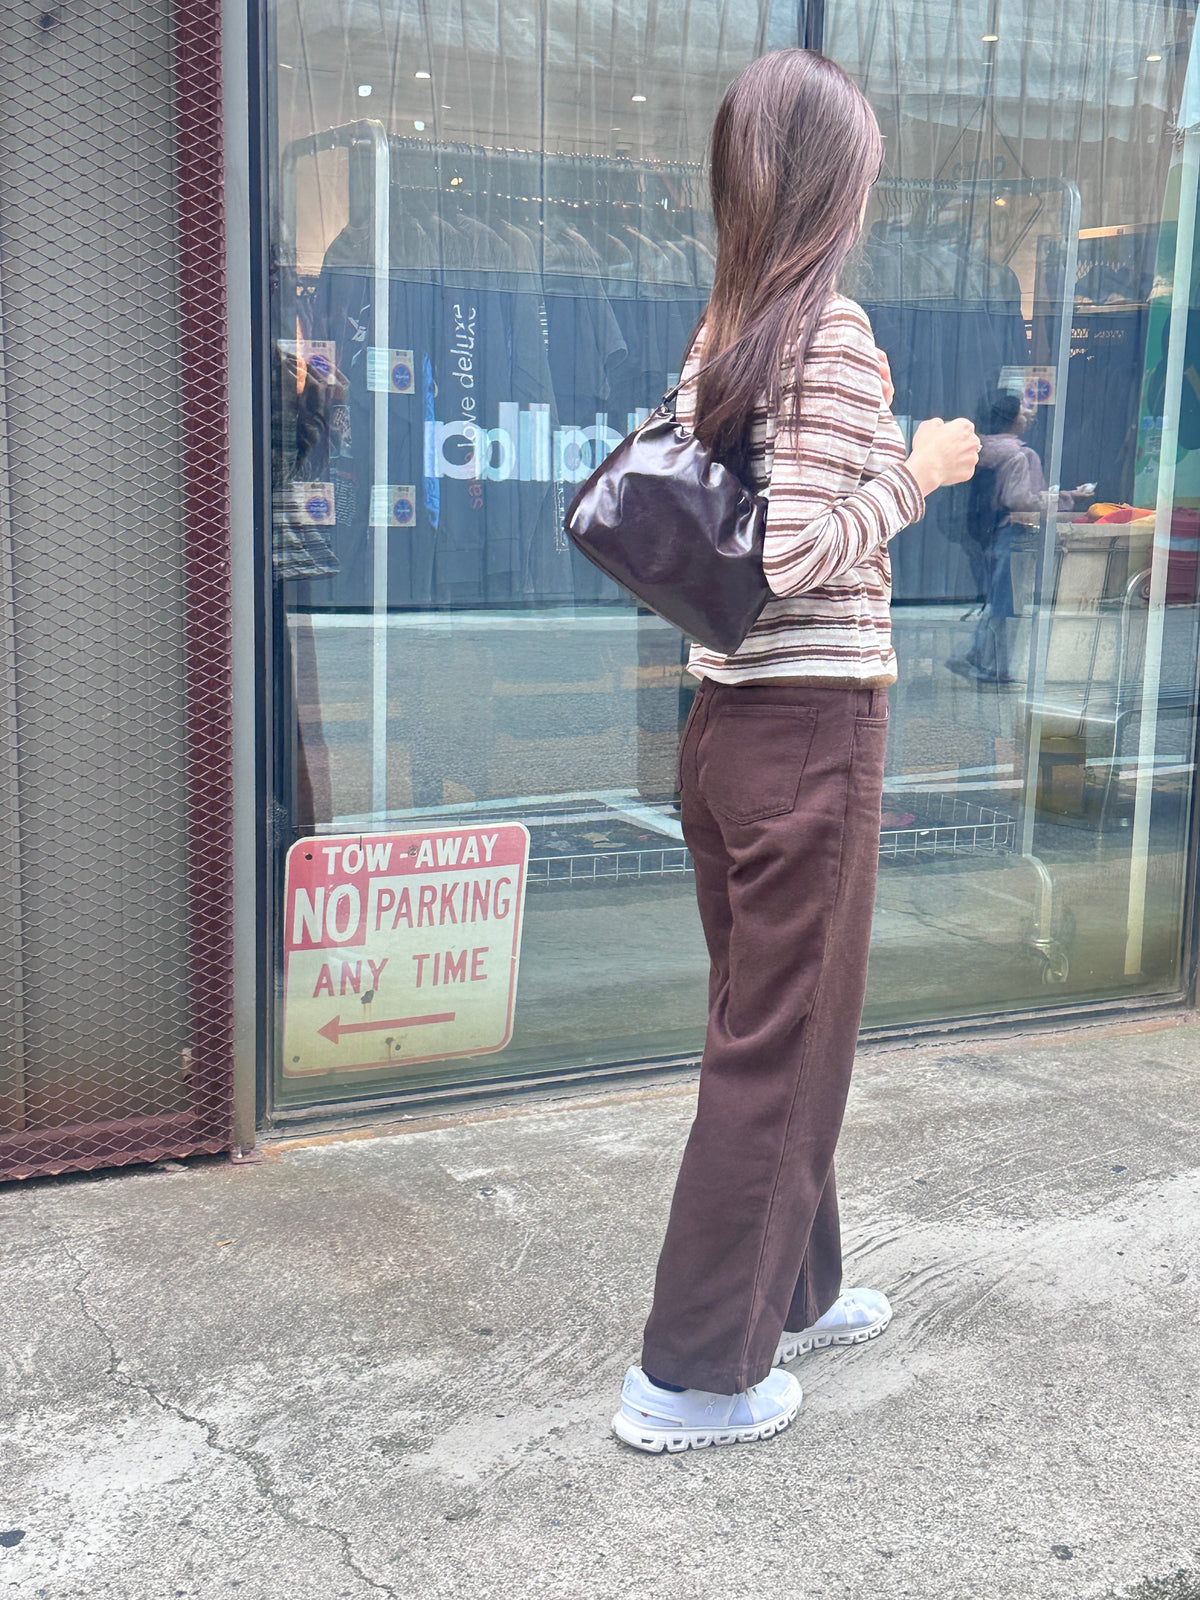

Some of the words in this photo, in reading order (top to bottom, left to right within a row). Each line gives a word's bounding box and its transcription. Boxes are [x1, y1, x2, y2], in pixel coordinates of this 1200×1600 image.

[450, 304, 476, 389] deluxe
[457, 396, 477, 447] love
[292, 883, 361, 944] NO
[375, 876, 512, 931] PARKING
[312, 957, 389, 998] ANY
[412, 946, 489, 988] TIME
